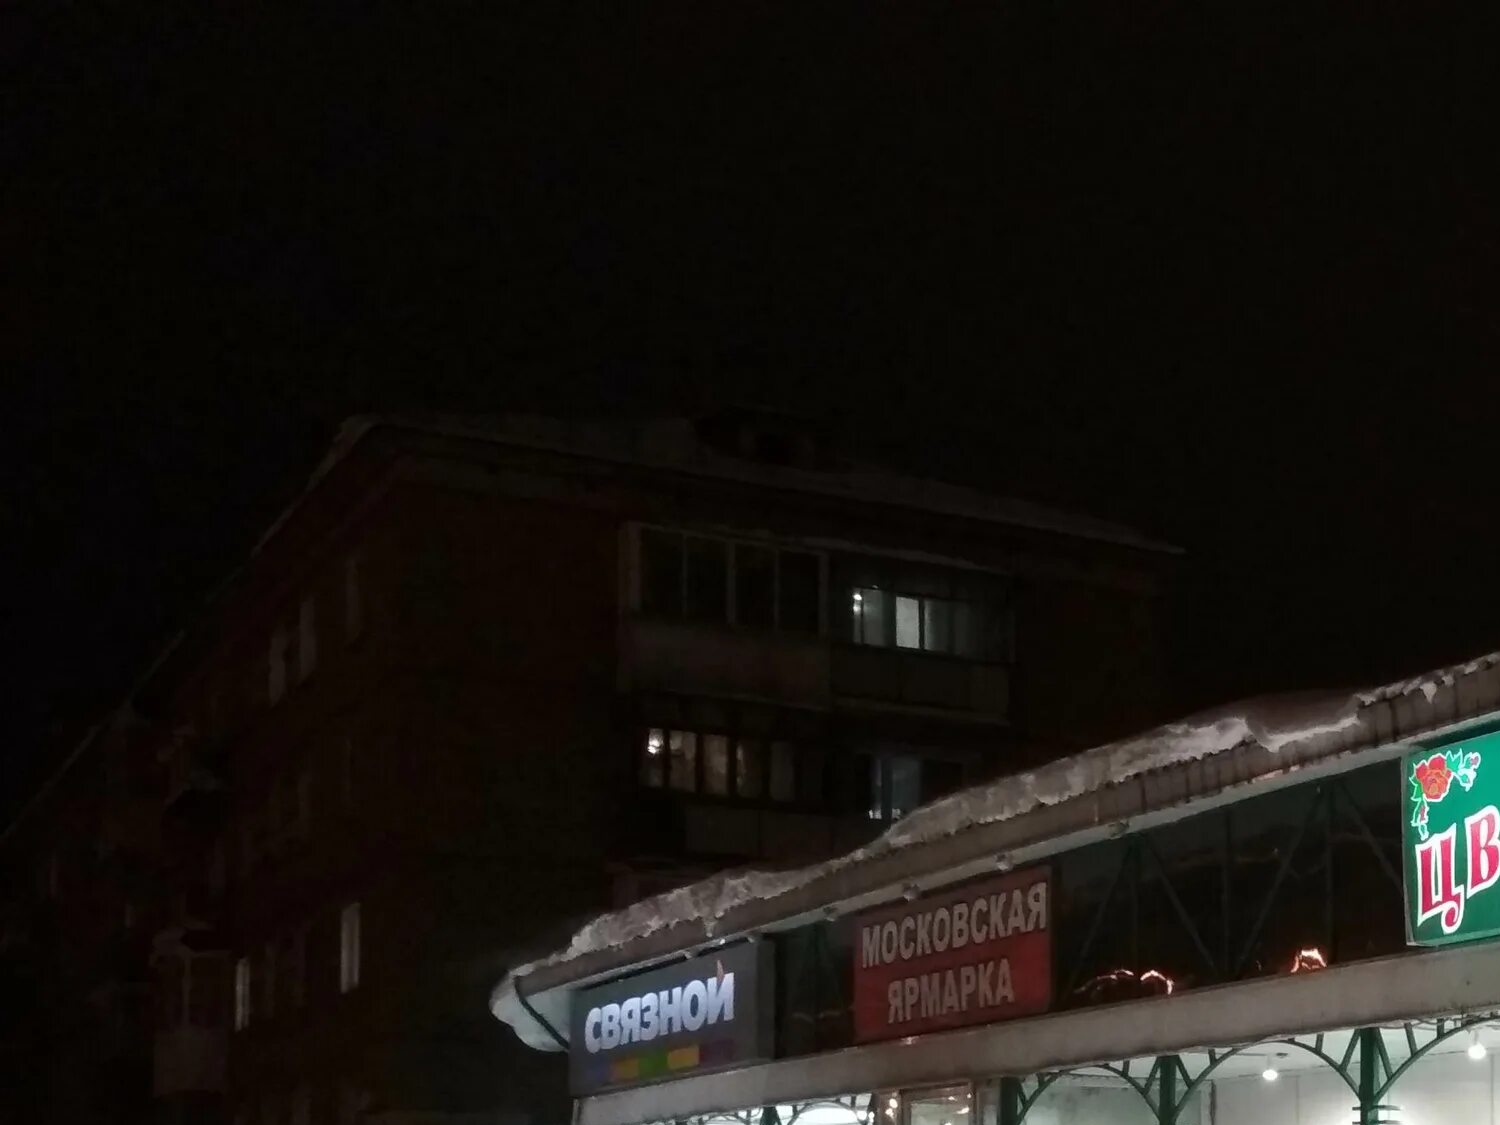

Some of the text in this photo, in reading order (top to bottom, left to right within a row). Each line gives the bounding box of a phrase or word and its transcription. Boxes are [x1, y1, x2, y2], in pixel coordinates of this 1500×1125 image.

[862, 882, 1049, 968] МОСКОВСКАЯ
[584, 960, 736, 1054] СВЯЗНОЙ
[888, 958, 1015, 1024] ЯРМАРКА
